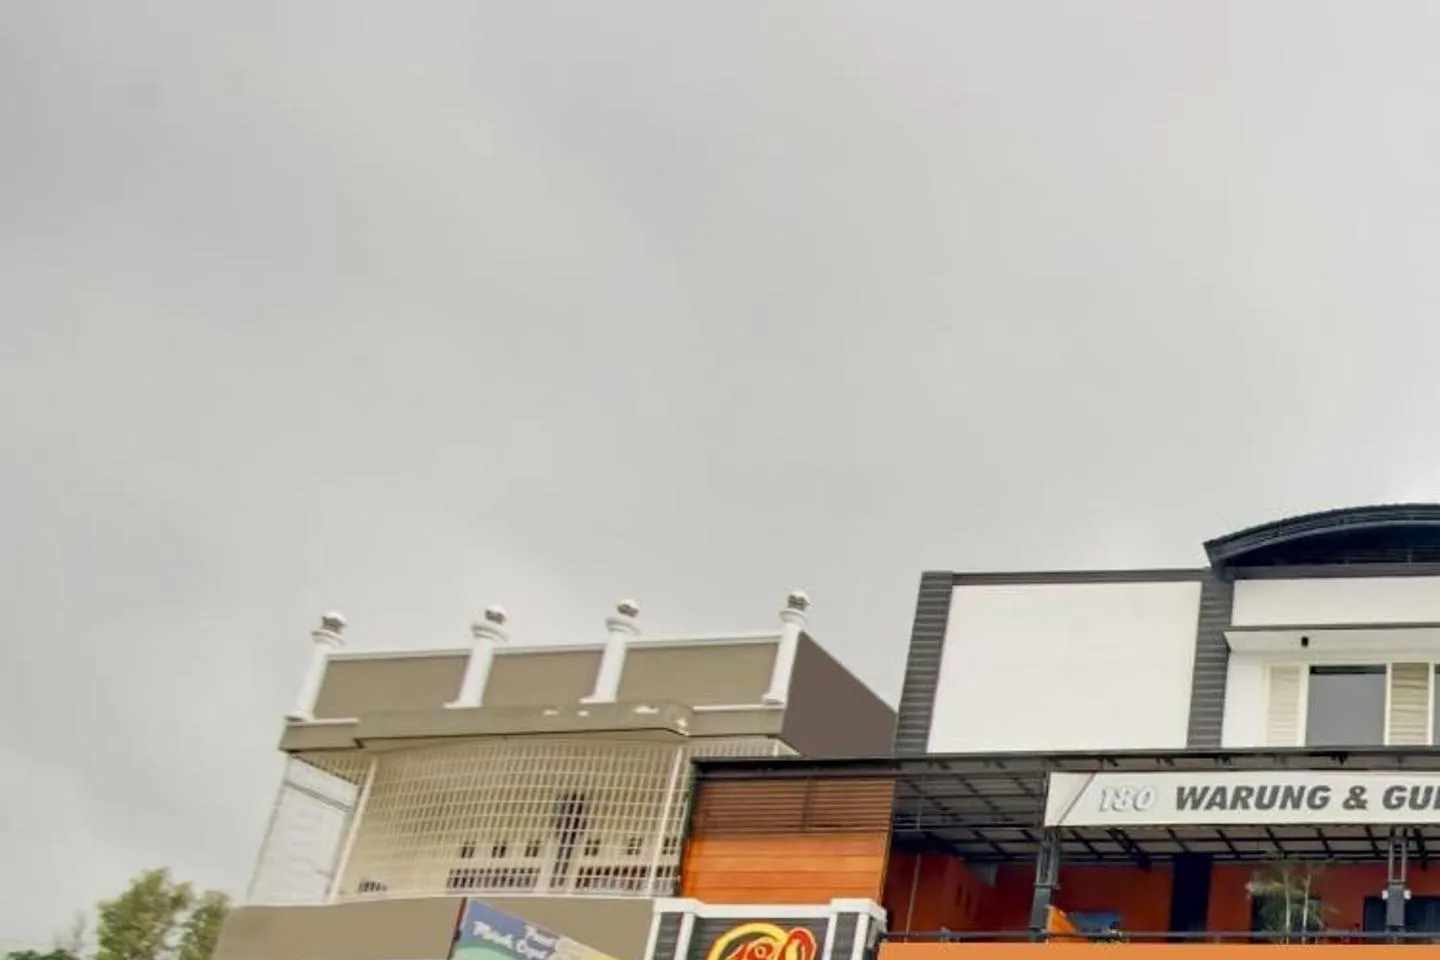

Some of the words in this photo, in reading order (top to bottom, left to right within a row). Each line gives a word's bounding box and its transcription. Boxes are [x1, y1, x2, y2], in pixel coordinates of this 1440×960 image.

[1099, 784, 1157, 812] 180
[1175, 785, 1332, 811] WARUNG
[1342, 785, 1368, 811] &
